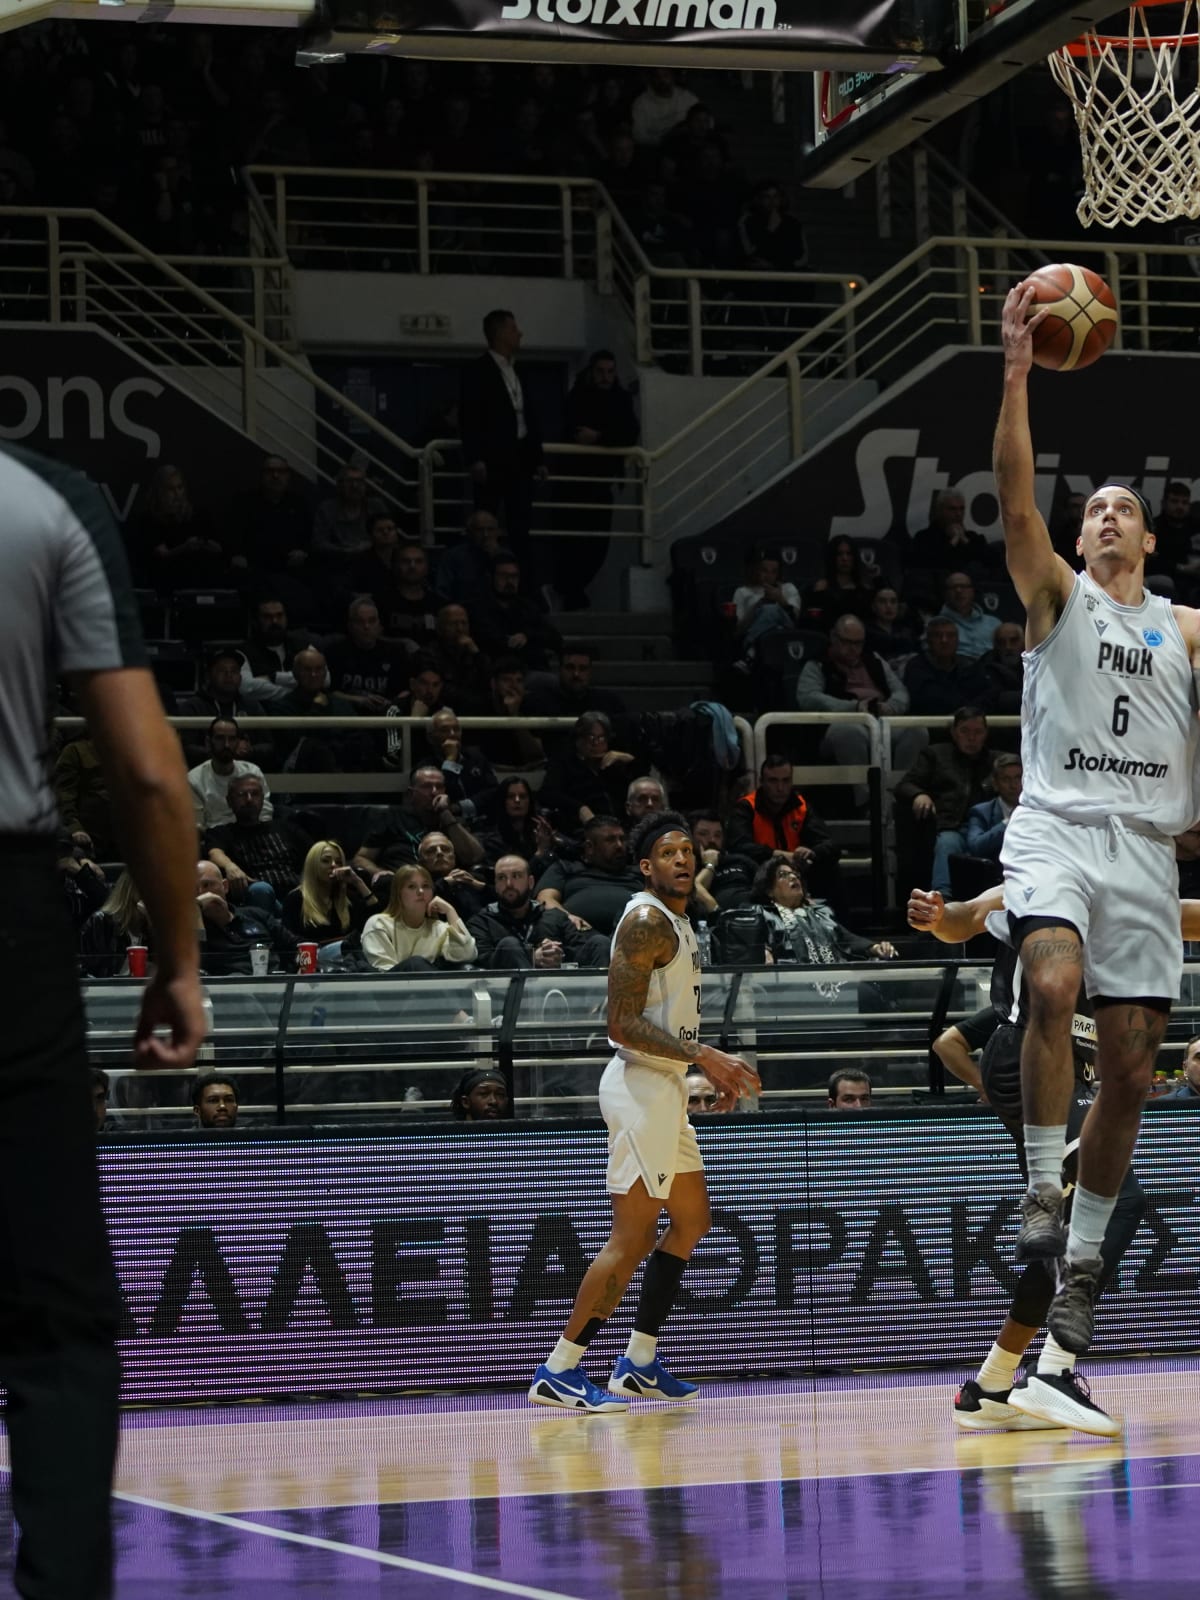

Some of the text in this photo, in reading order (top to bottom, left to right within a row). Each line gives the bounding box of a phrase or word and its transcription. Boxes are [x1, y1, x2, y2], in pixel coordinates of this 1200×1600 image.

[1097, 642, 1152, 677] PAOK
[1111, 695, 1130, 737] 6
[1064, 748, 1168, 779] Stoiximan
